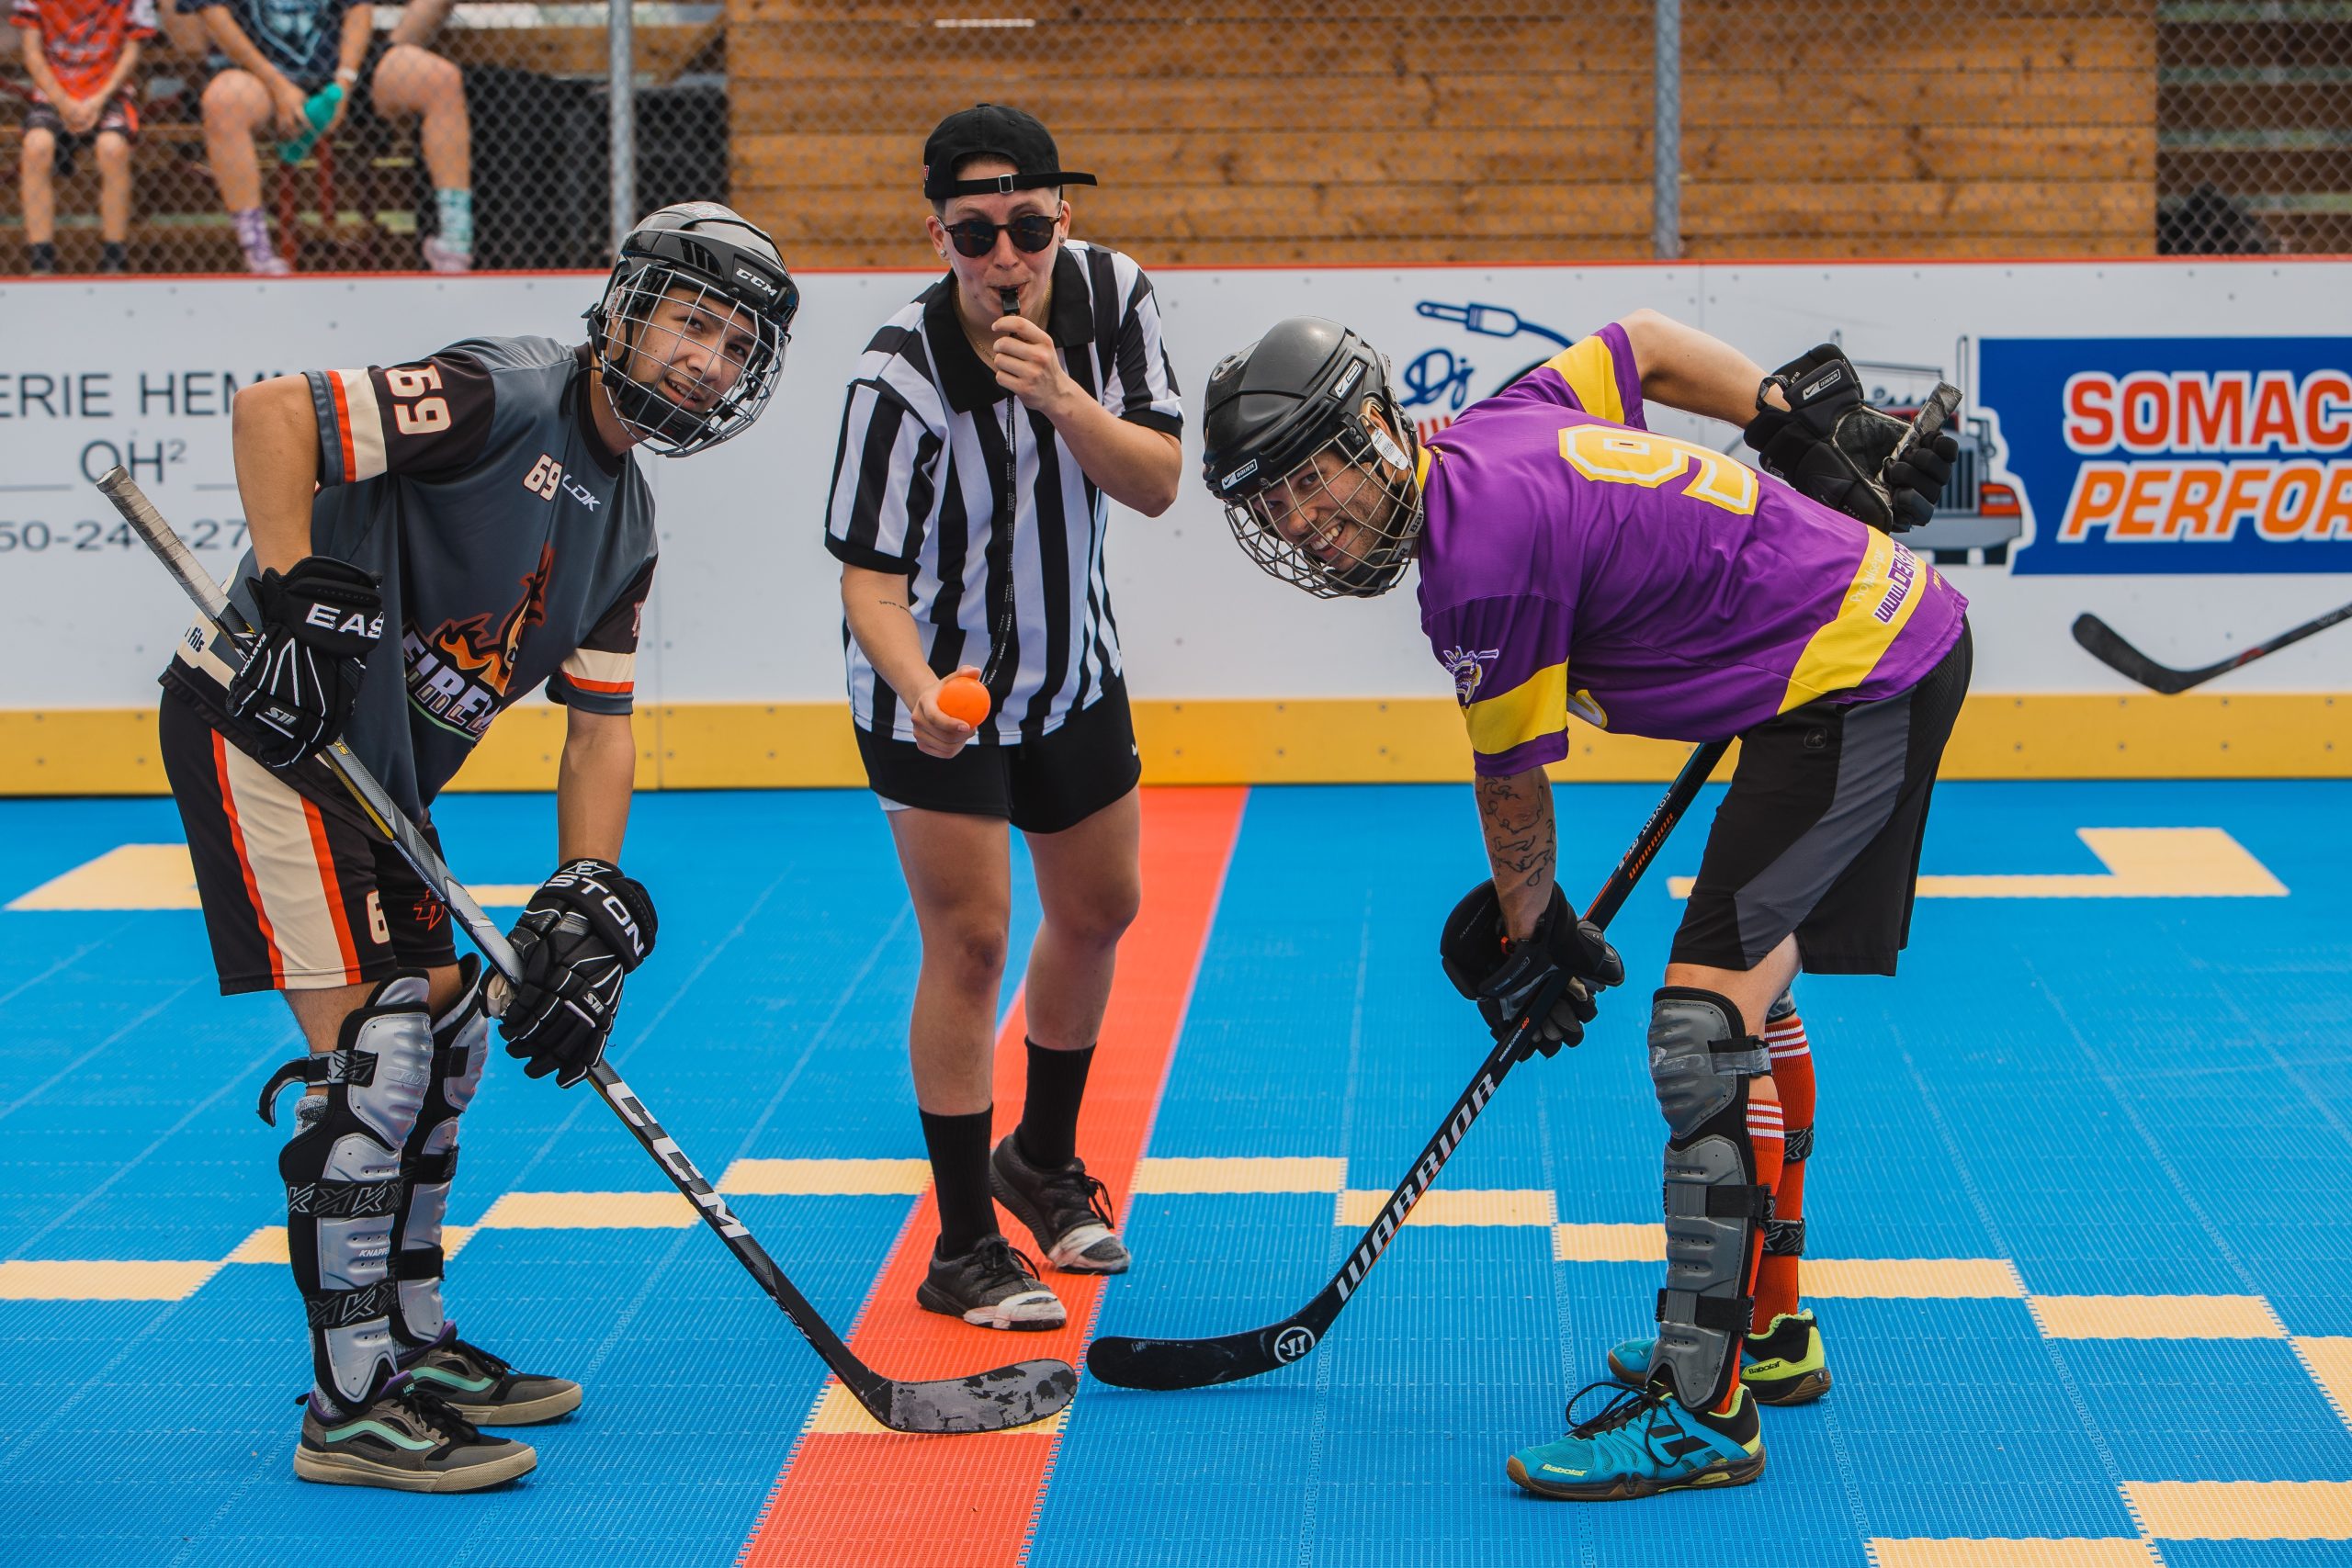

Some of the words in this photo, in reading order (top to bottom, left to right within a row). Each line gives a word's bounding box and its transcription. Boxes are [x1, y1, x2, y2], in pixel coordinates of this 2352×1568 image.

[735, 267, 779, 297] CCM
[385, 365, 452, 435] 69
[2065, 375, 2352, 451] SOMAC
[522, 453, 564, 502] 69
[562, 474, 601, 512] LDK
[1557, 423, 1759, 515] 9
[2060, 462, 2352, 540] PERFOR
[240, 633, 267, 677] EASTON
[1641, 792, 1672, 836] COVERT
[1628, 812, 1675, 880] WARRIOR
[606, 1081, 750, 1238] CCM
[1336, 1073, 1497, 1303] WARRIOR
[1748, 1360, 1781, 1375] Babolat
[1542, 1462, 1588, 1477] Babolat
